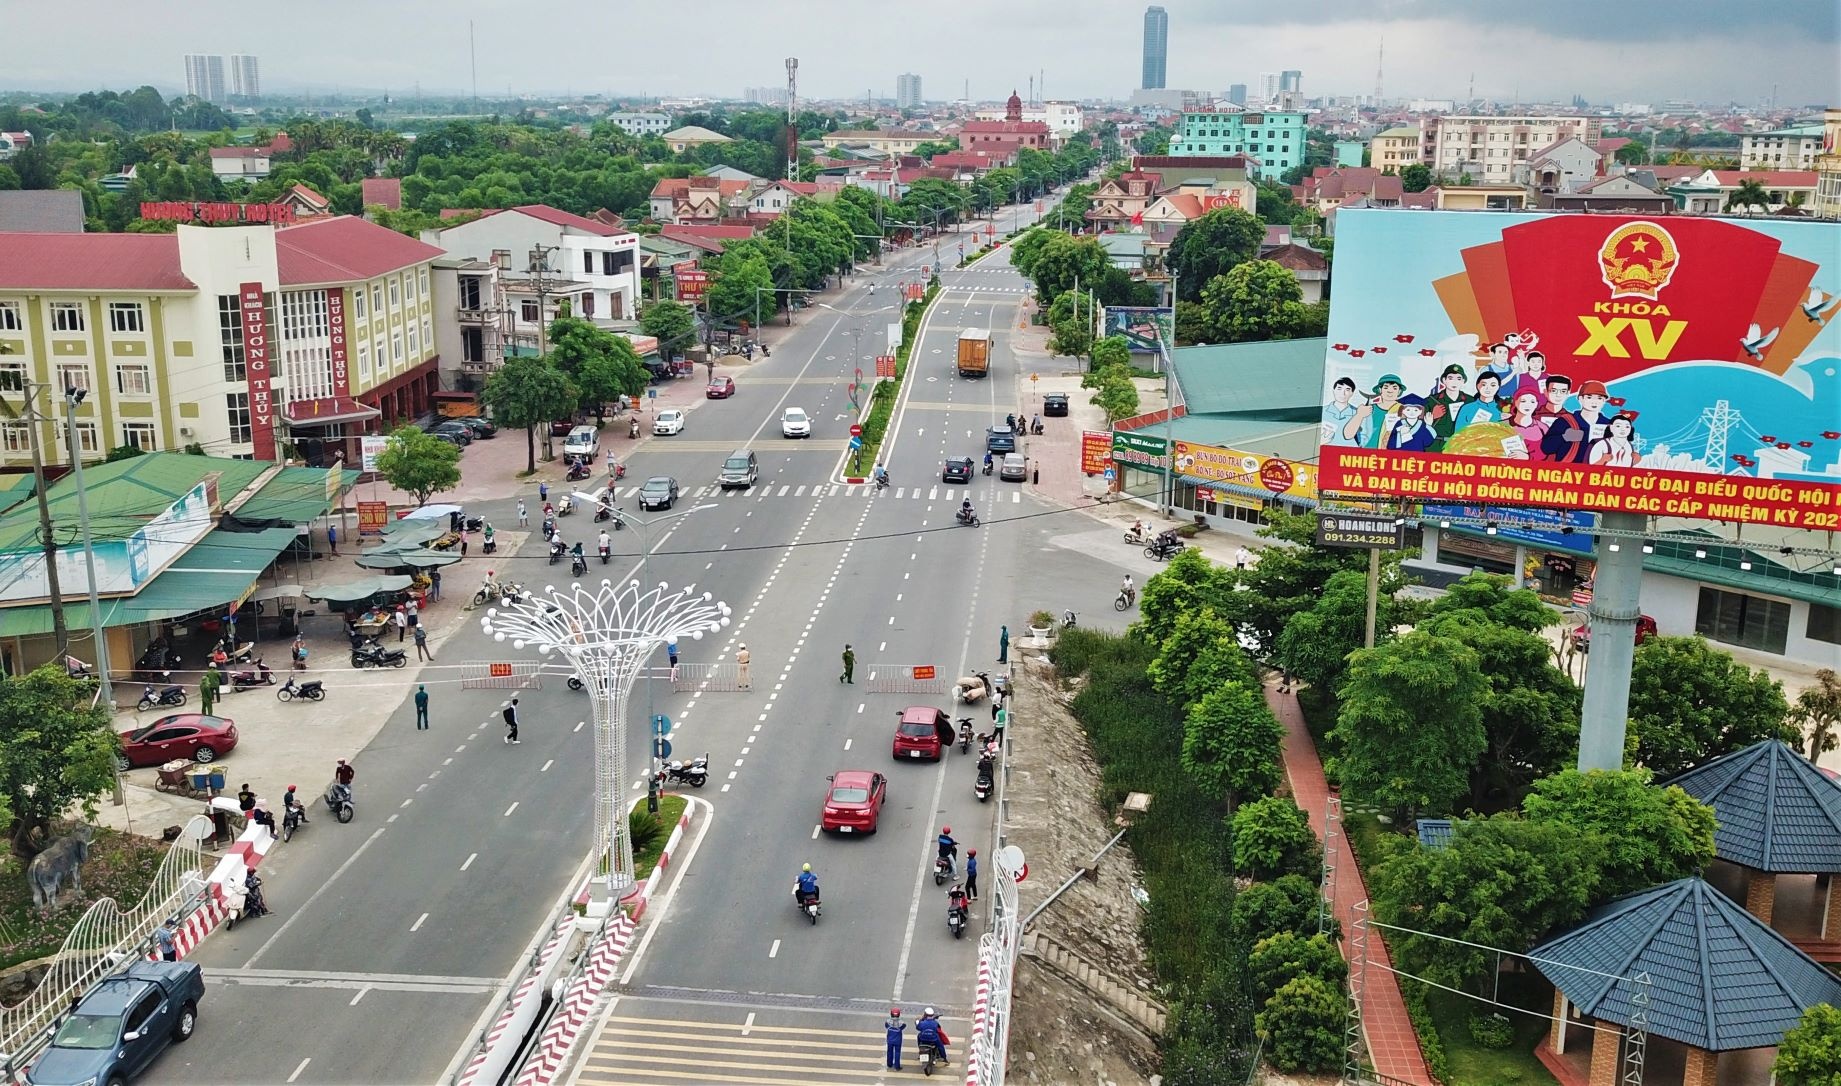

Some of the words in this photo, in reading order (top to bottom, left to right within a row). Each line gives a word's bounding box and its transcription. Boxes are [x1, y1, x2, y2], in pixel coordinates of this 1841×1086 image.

[1594, 301, 1671, 316] KHÓA
[1572, 315, 1689, 360] XV
[1339, 454, 1388, 471] NHIỆT
[1391, 457, 1426, 474] LIỆT
[1430, 460, 1476, 477] CHÀO
[1480, 463, 1533, 481] MỪNG
[1537, 467, 1585, 485] NGÀY
[1588, 470, 1626, 488] BẦU
[1630, 471, 1657, 489] CỬ
[1658, 478, 1690, 493] ĐẠI
[1695, 478, 1738, 498] BIỂU
[1742, 483, 1793, 502] QUỐC
[1798, 488, 1831, 507] HỘI
[1342, 474, 1364, 488] VÀ
[1367, 477, 1396, 491] ĐẠI
[1401, 476, 1439, 494] BIỂU
[1443, 481, 1473, 497] HỘI
[1476, 481, 1525, 501] ĐỒNG
[1529, 488, 1579, 505] NHÂN
[1583, 491, 1620, 508] DÂN
[1625, 494, 1662, 511] CÁC
[1665, 497, 1704, 515] CẤP
[1707, 504, 1769, 523] NHIỆM
[1774, 507, 1800, 524] KỲ
[1803, 511, 1840, 527] 202
[1324, 533, 1396, 545] 091.234.2288
[1338, 520, 1397, 533] HOANGLONG
